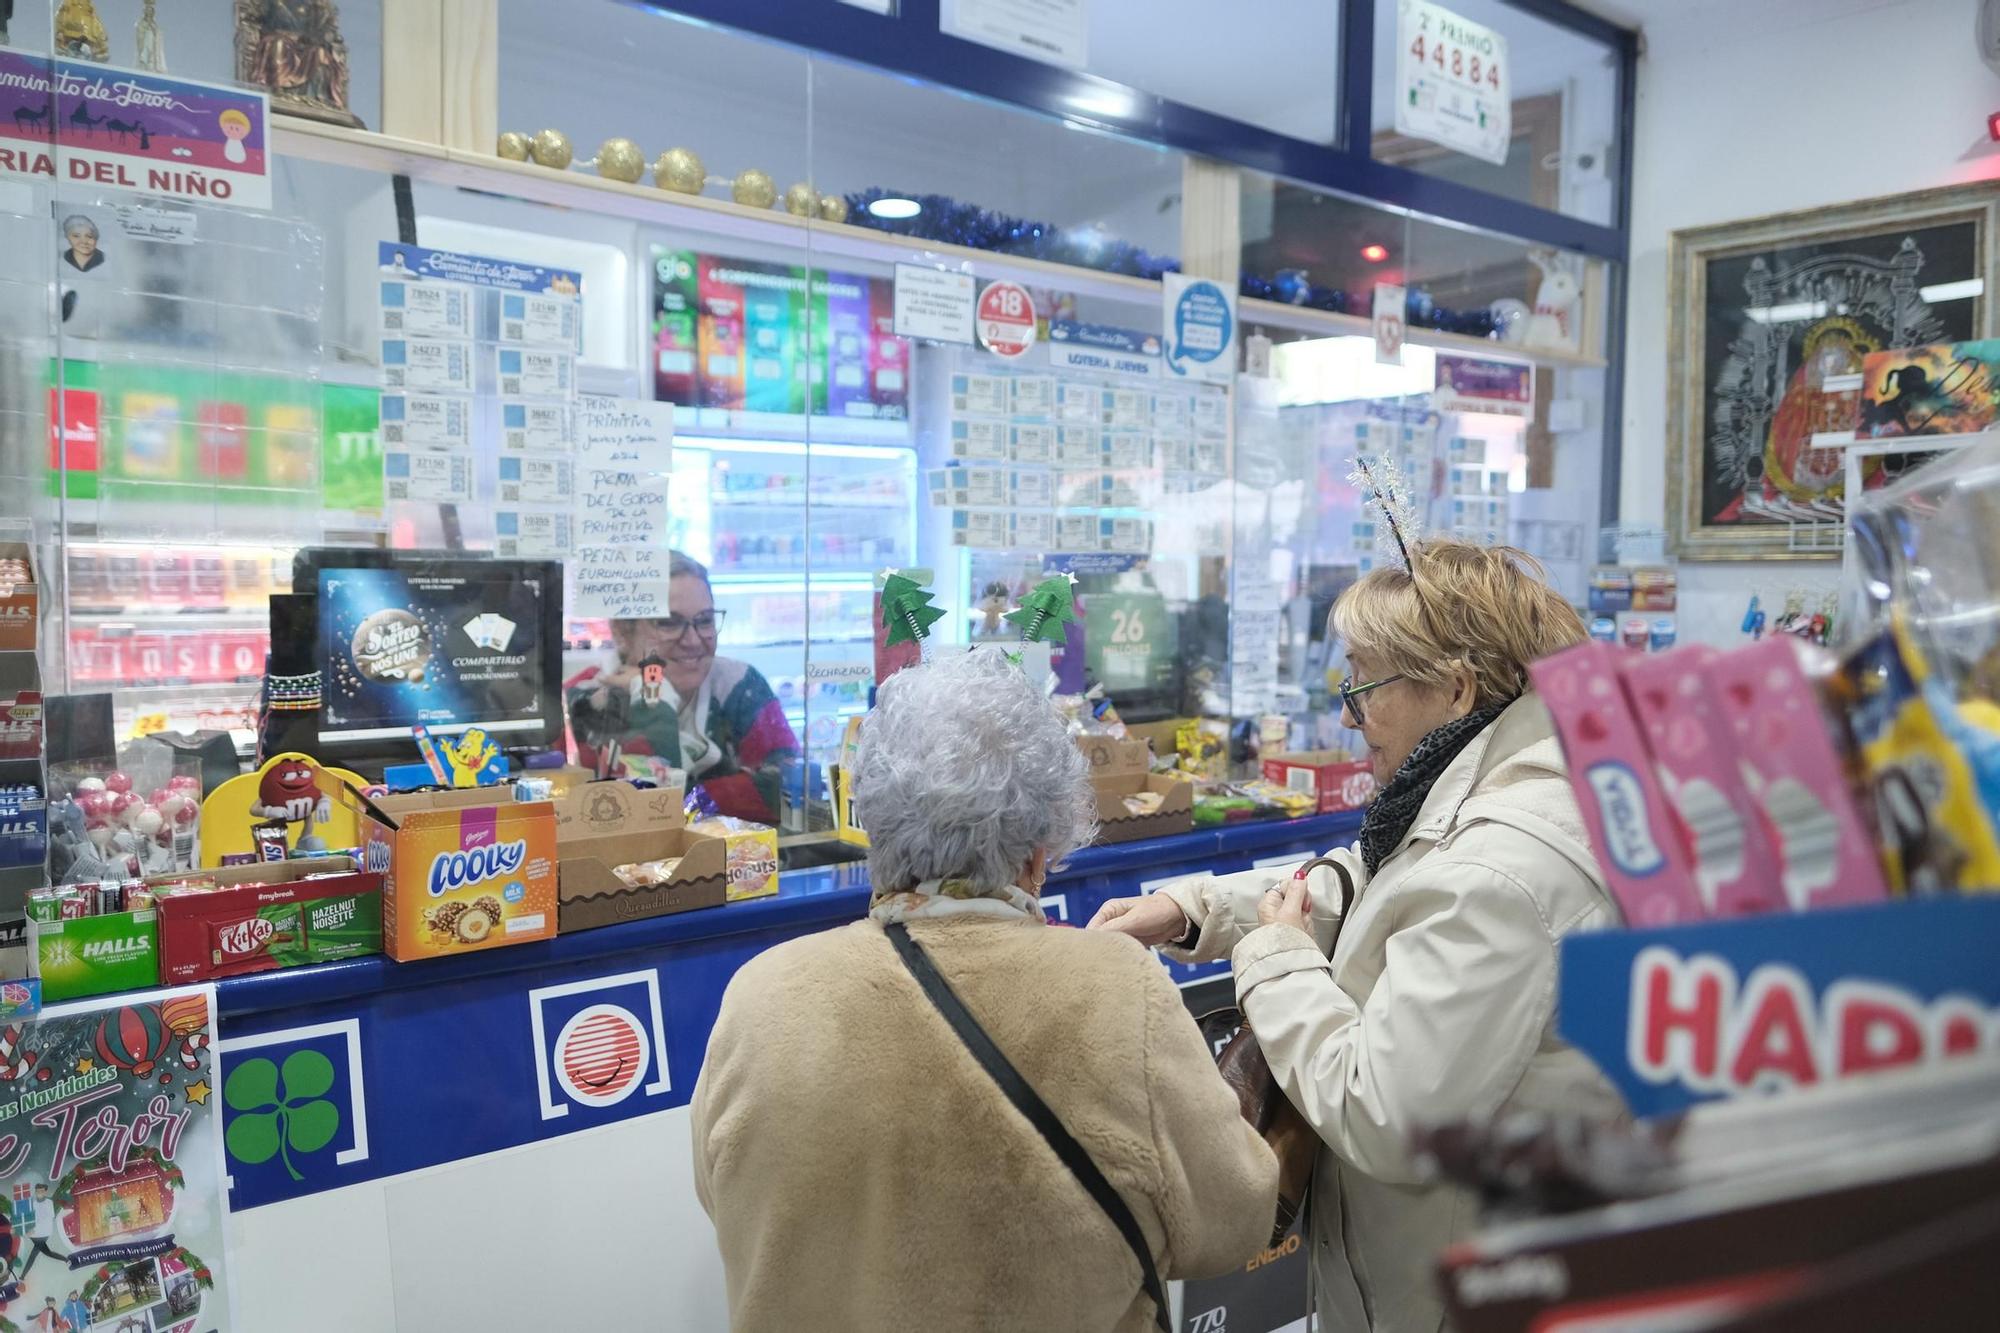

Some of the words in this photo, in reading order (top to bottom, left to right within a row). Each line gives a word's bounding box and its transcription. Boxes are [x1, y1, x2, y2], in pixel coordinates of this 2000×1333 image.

[1410, 35, 1499, 91] 44884
[69, 158, 136, 187] DEL
[148, 168, 232, 200] NIÑO
[989, 288, 1023, 317] +18
[1110, 608, 1145, 643] 26
[452, 655, 526, 668] COMPARTIRLO
[258, 890, 295, 902] #mybreak
[312, 898, 356, 920] HAZELNUT
[227, 920, 271, 952] KitKat
[313, 910, 354, 930] NOISETTE
[20, 1065, 118, 1113] Navidades
[31, 1084, 192, 1181] Teror
